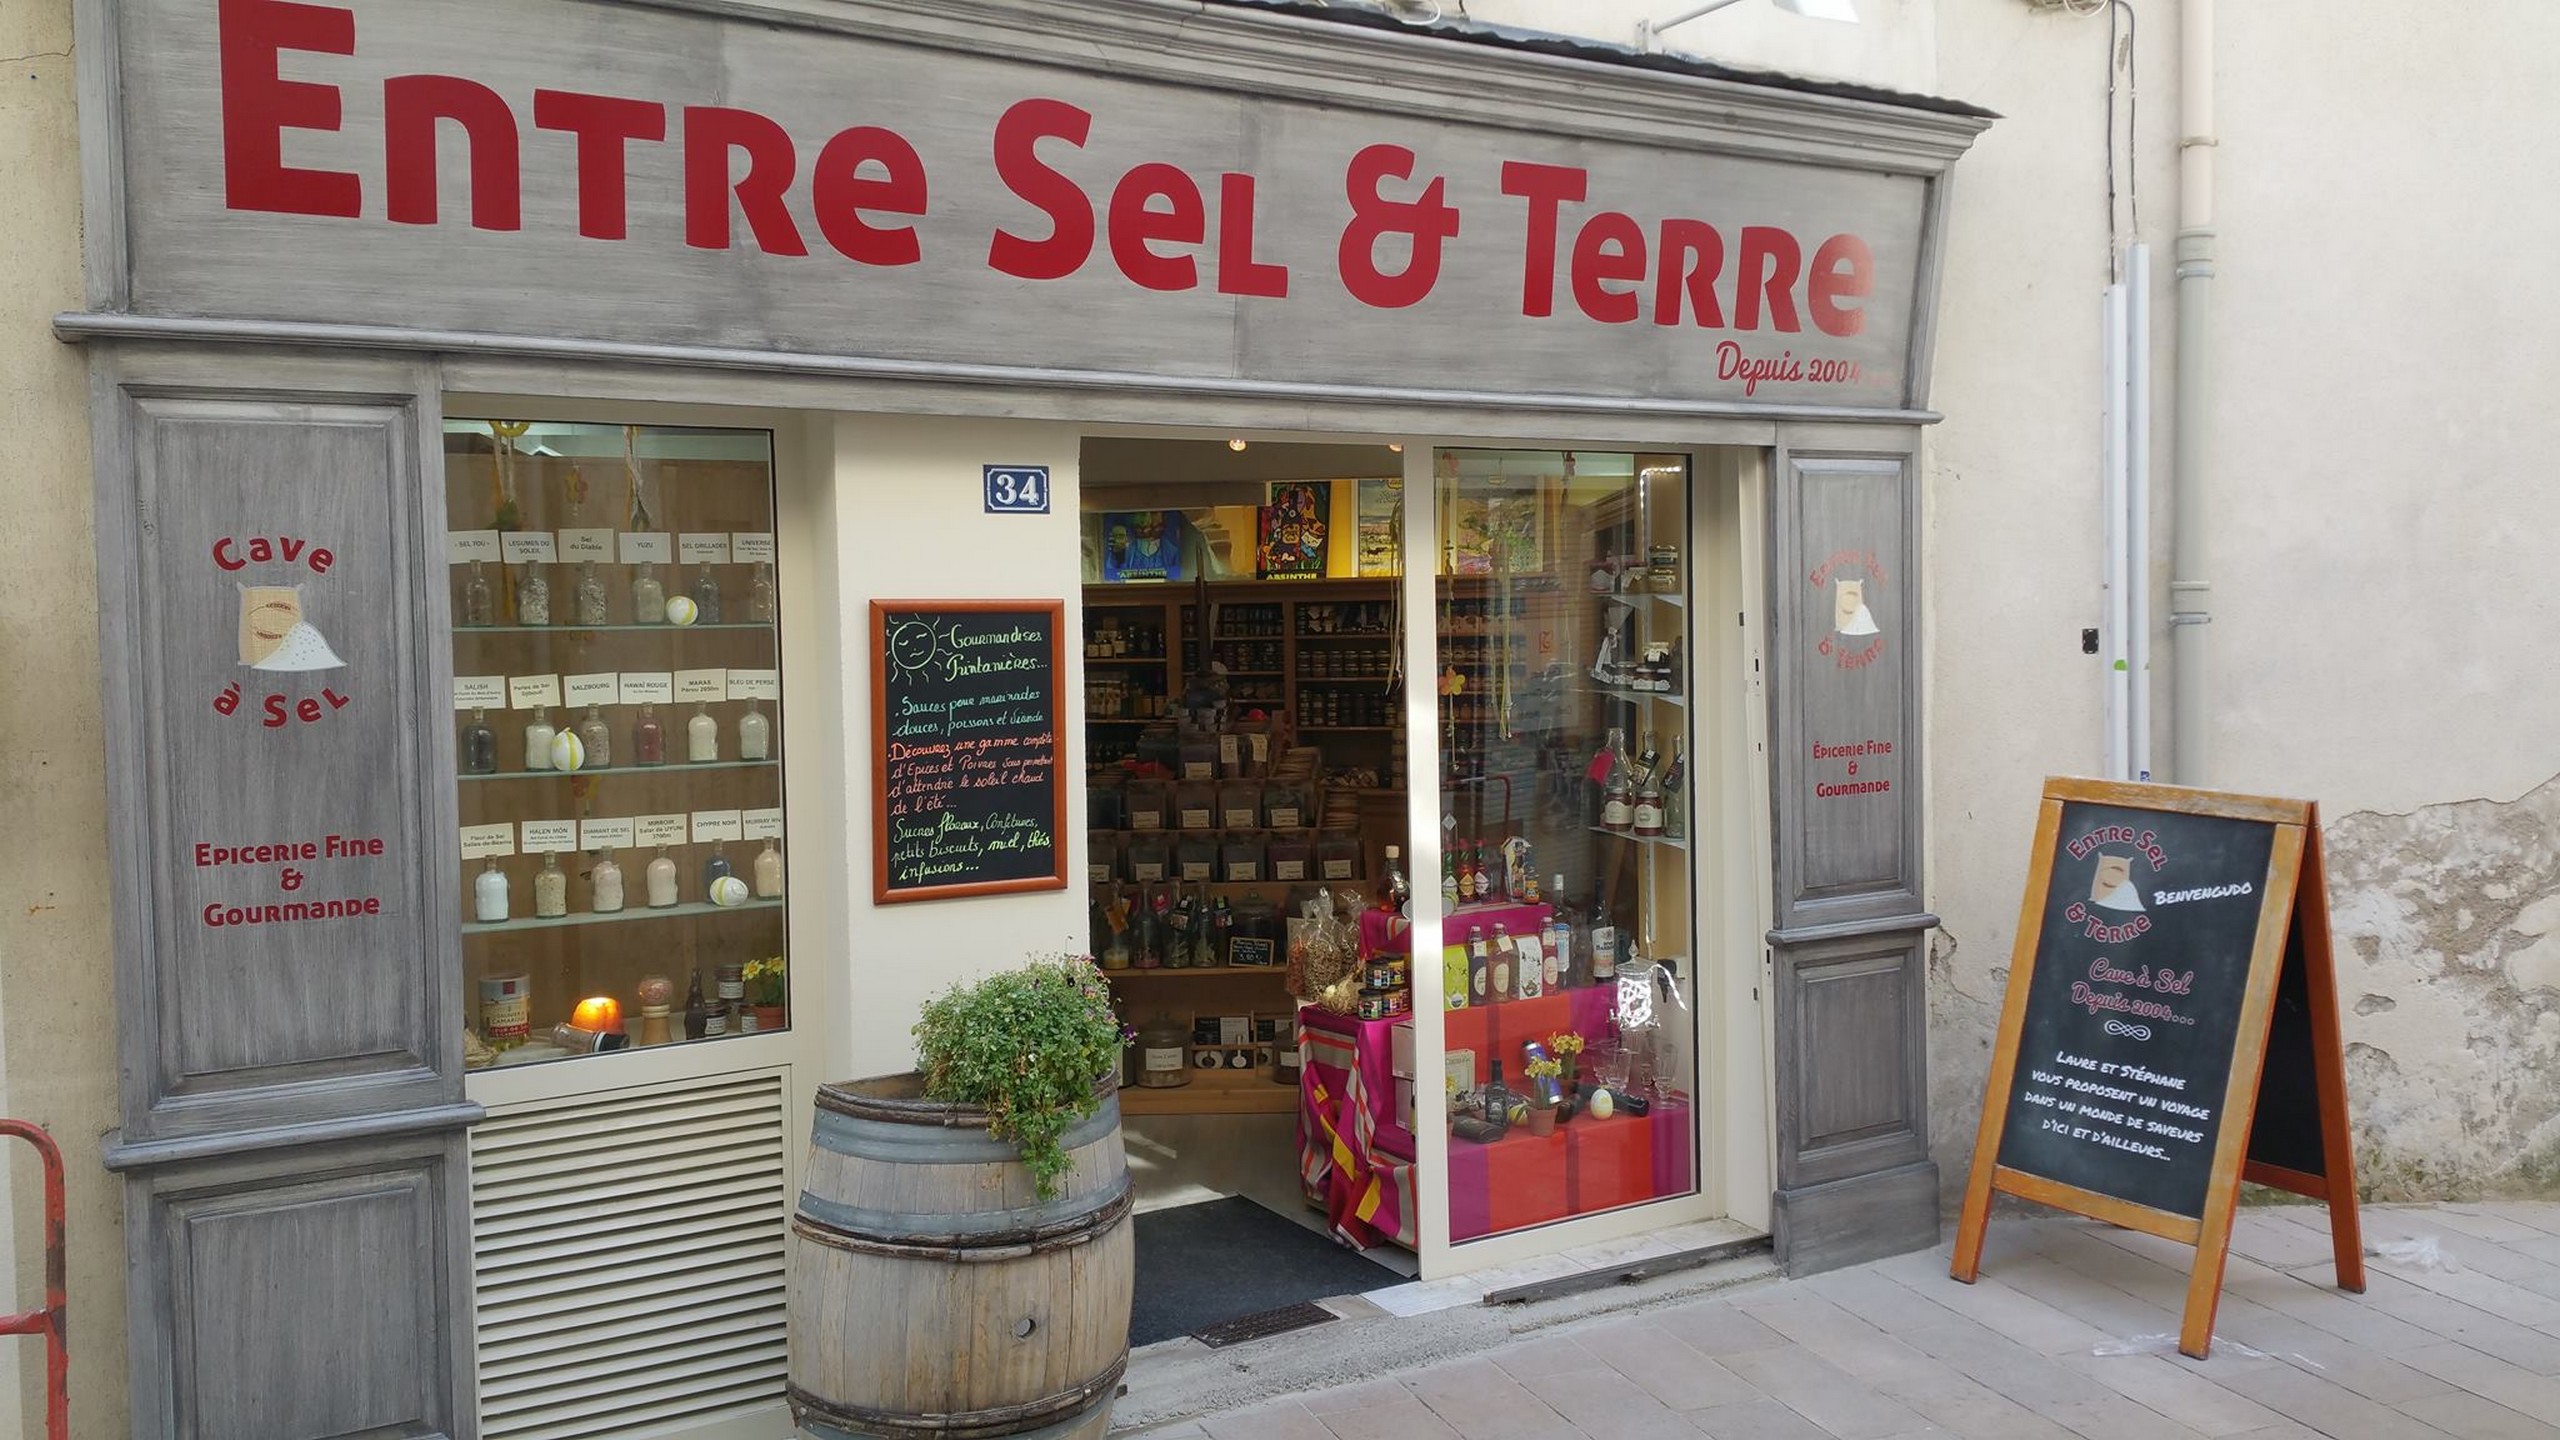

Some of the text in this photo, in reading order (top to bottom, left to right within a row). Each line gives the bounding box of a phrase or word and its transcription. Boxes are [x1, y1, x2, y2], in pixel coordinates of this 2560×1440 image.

[1338, 143, 1459, 309] &
[1716, 340, 1804, 397] Depuis
[995, 474, 1040, 506] 34
[212, 536, 335, 574] Cave
[949, 624, 1043, 649] Gourmandises
[212, 680, 243, 718] à
[949, 697, 975, 719] pour
[977, 687, 1041, 707] marinades
[996, 712, 1008, 726] et
[953, 741, 976, 752] une
[978, 738, 1019, 756] gamme
[941, 757, 954, 773] et
[1847, 761, 1858, 775] &
[959, 774, 970, 788] le
[973, 771, 1007, 788] soleil
[1011, 769, 1045, 784] chaud
[891, 799, 908, 817] de
[893, 818, 935, 844] Sucres
[891, 843, 925, 868] petits
[280, 868, 303, 891] &
[2064, 902, 2087, 924] &
[2088, 956, 2195, 996] Cave à Sel
[2071, 980, 2131, 1016] Depuis
[2056, 1050, 2099, 1072] LAURE
[2100, 1063, 2121, 1077] ET
[2031, 1069, 2211, 1121] VOUS PROPOSENT UN VOYAGE
[2024, 1091, 2204, 1144] DANS UN MONDE DE SAVEURS
[2073, 1127, 2092, 1140] ET
